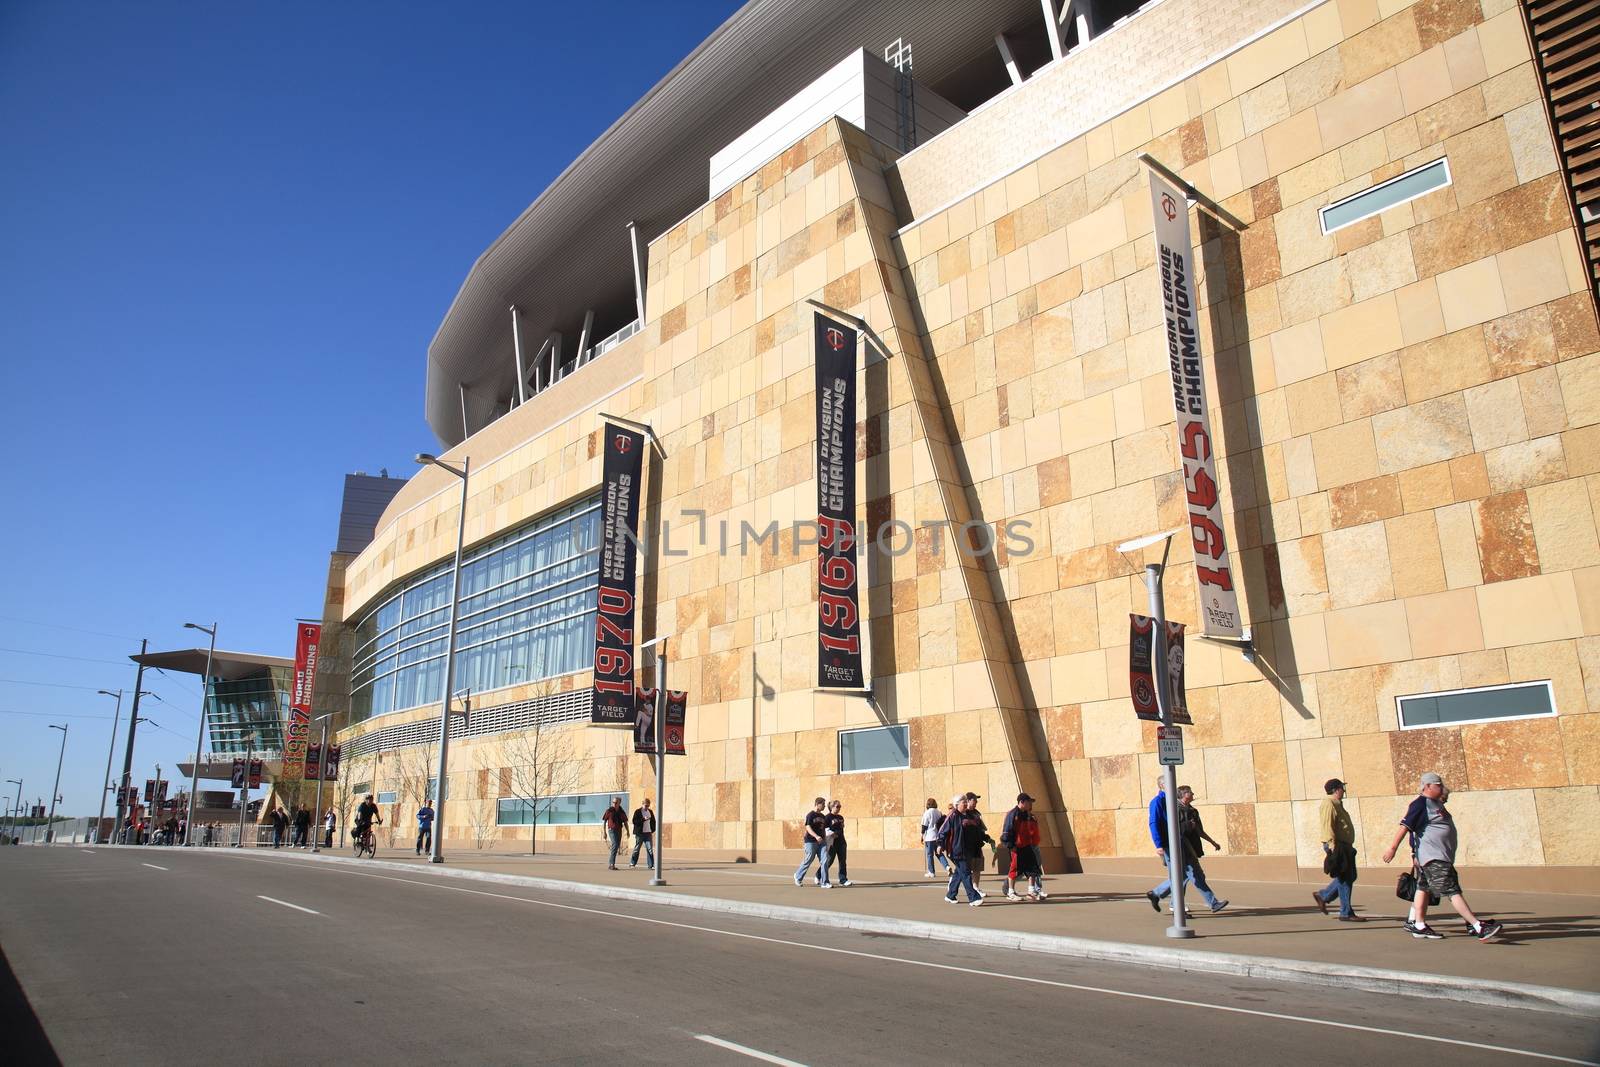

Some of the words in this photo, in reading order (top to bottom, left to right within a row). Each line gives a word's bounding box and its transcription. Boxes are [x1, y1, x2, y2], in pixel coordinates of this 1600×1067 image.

[1160, 243, 1174, 313] LEAGUE
[1172, 251, 1202, 416] CHAMPIONS
[1165, 317, 1187, 414] AMERICAN
[820, 387, 832, 460] DIVISION
[828, 377, 847, 512] CHAMPIONS
[605, 480, 617, 539] DIVISION
[820, 463, 829, 508] WEST
[612, 473, 632, 581] CHAMPIONS
[602, 543, 613, 578] WEST
[818, 513, 860, 655] 1969
[594, 585, 633, 696] 1970
[1207, 606, 1234, 621] TARGET
[1211, 617, 1234, 629] FIELD
[294, 671, 305, 705] WORLD
[302, 644, 317, 706] CHAMPIONS
[823, 664, 855, 676] TARGET
[827, 672, 853, 682] FIELD
[285, 707, 311, 763] 1987
[597, 704, 628, 714] TARGET
[601, 711, 625, 719] FIELD
